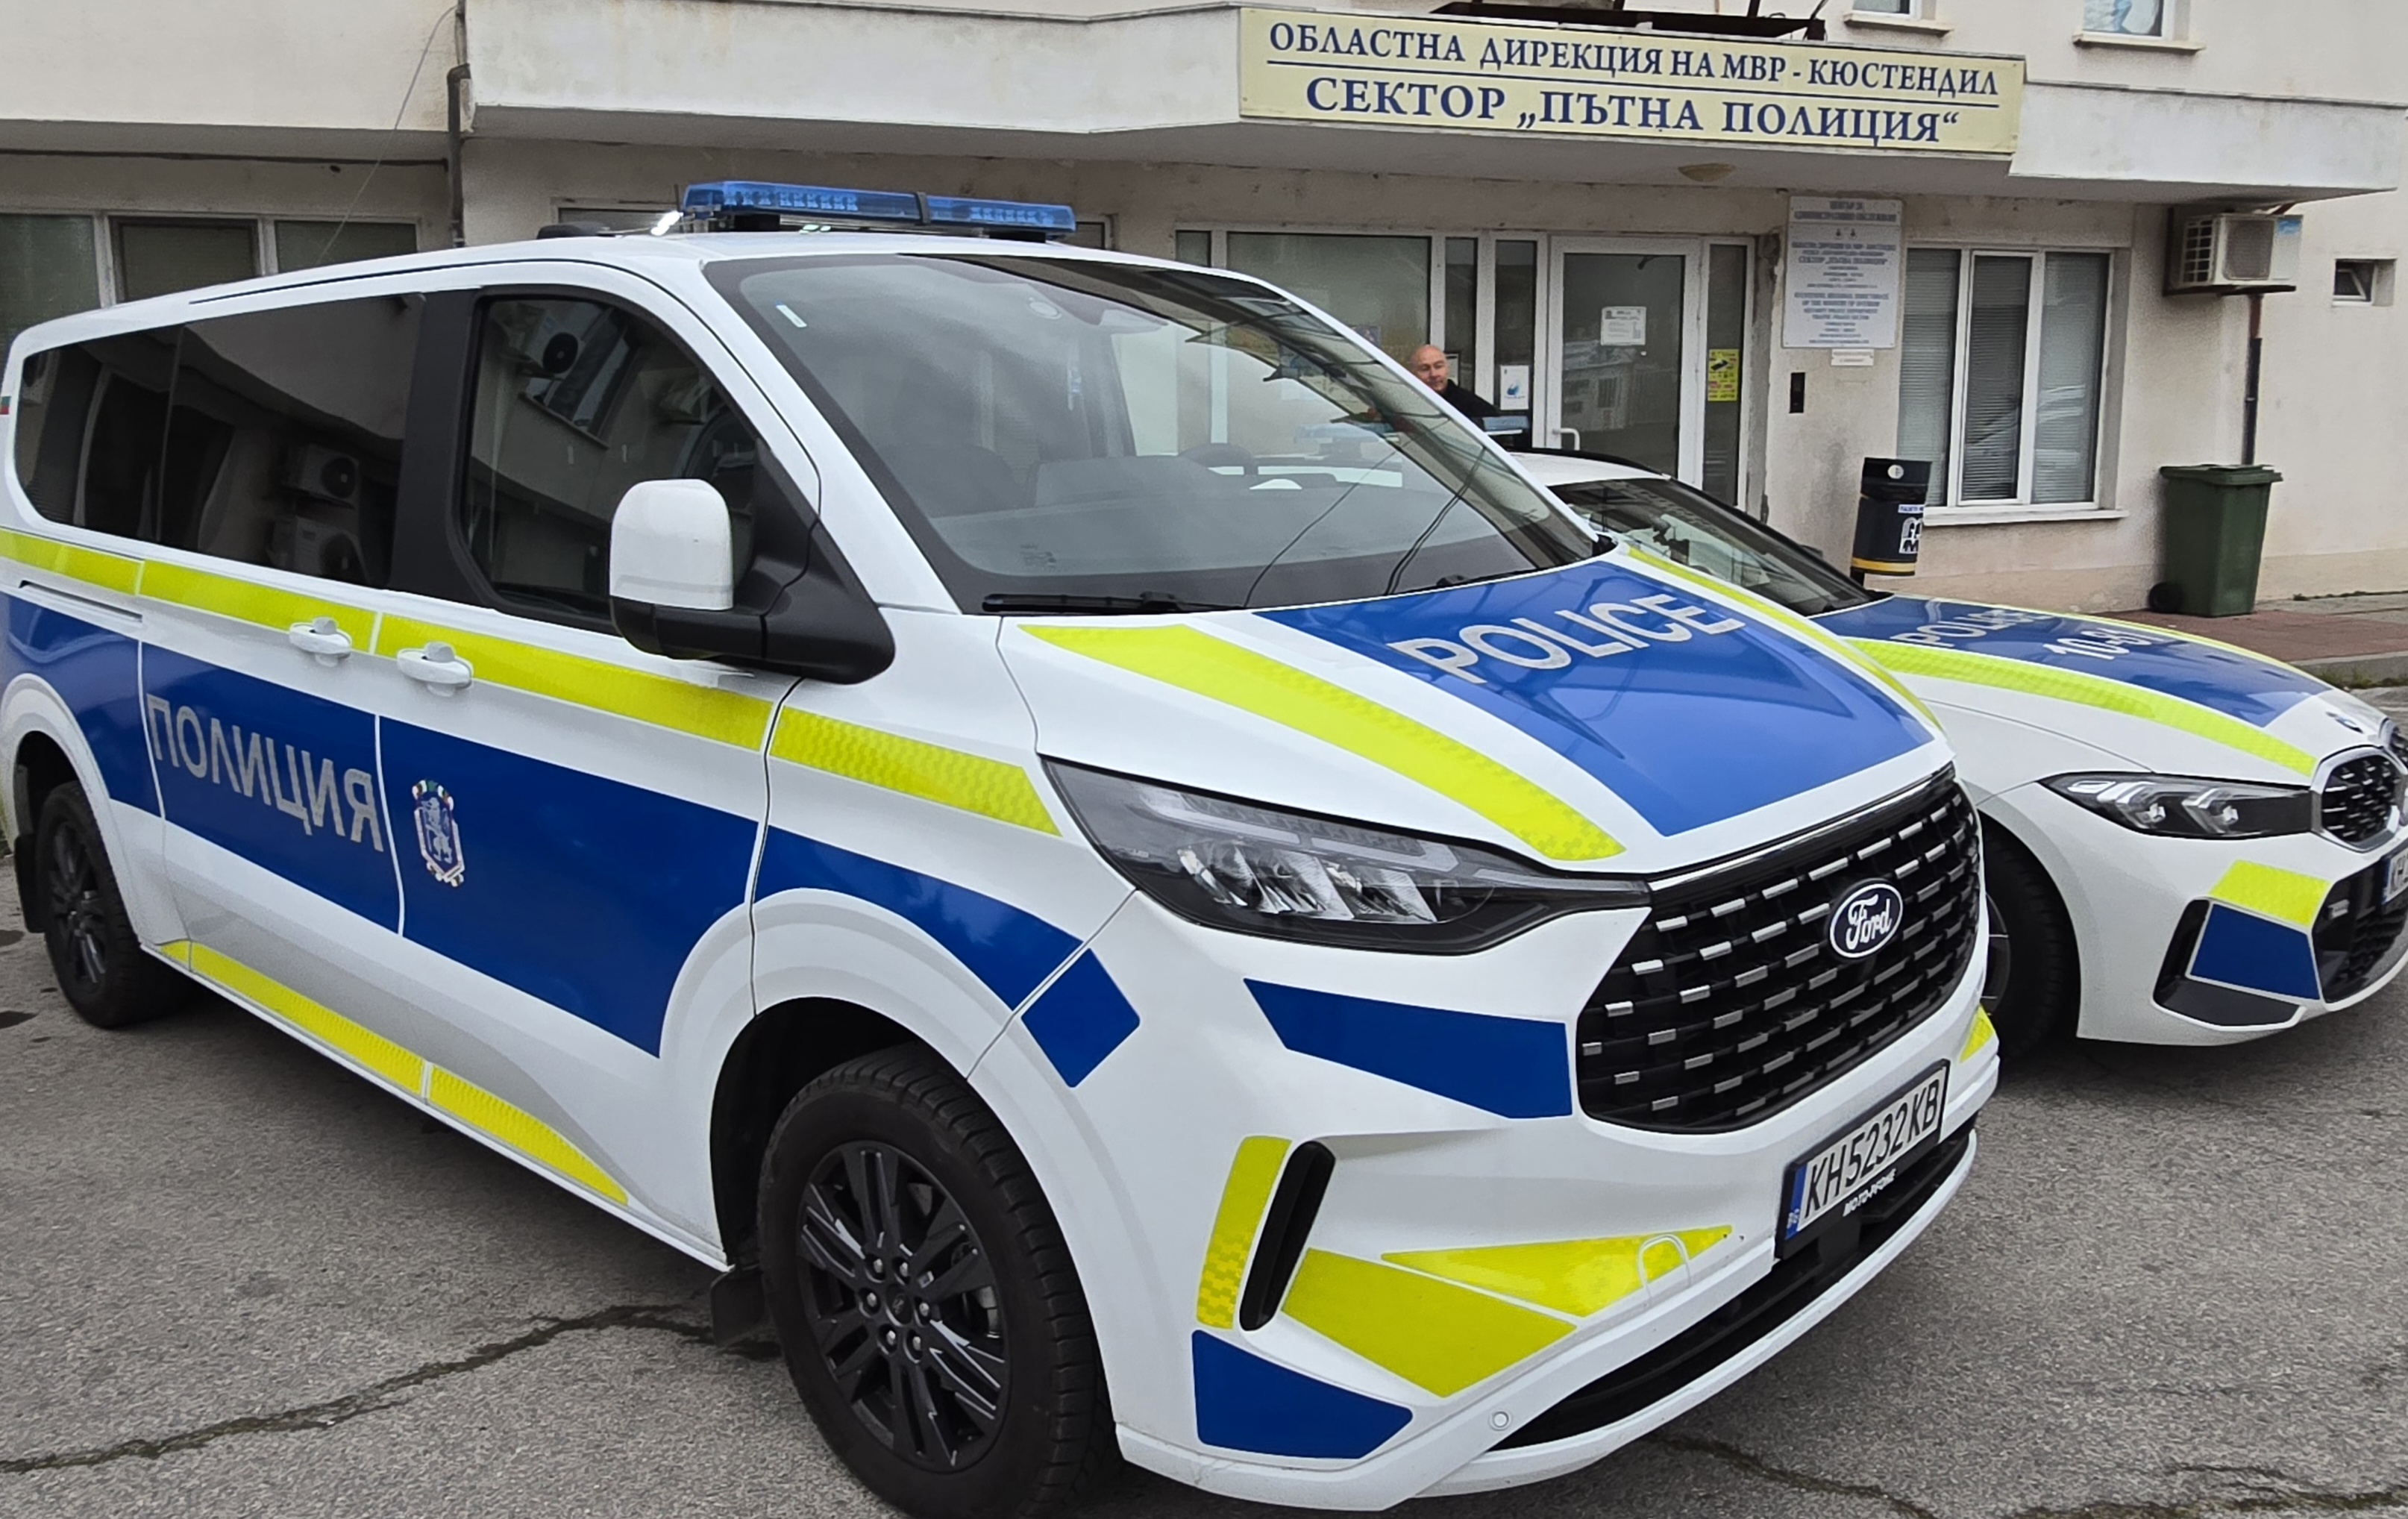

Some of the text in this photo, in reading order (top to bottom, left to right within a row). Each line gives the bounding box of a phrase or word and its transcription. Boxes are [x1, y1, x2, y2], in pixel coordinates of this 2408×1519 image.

[1270, 22, 1465, 61] ОБЛАСТНА
[1480, 38, 1663, 78] ДИРЕКЦИЯ
[1669, 50, 1715, 78] НА
[1720, 53, 1786, 82] МВР
[1807, 59, 1998, 98] КЮСТЕНДИЛ
[1307, 78, 1505, 119] СЕКТОР
[1386, 594, 1746, 684] POLICE
[146, 693, 384, 853] ПОЛИЦИЯ
[1846, 894, 1893, 950] Ford
